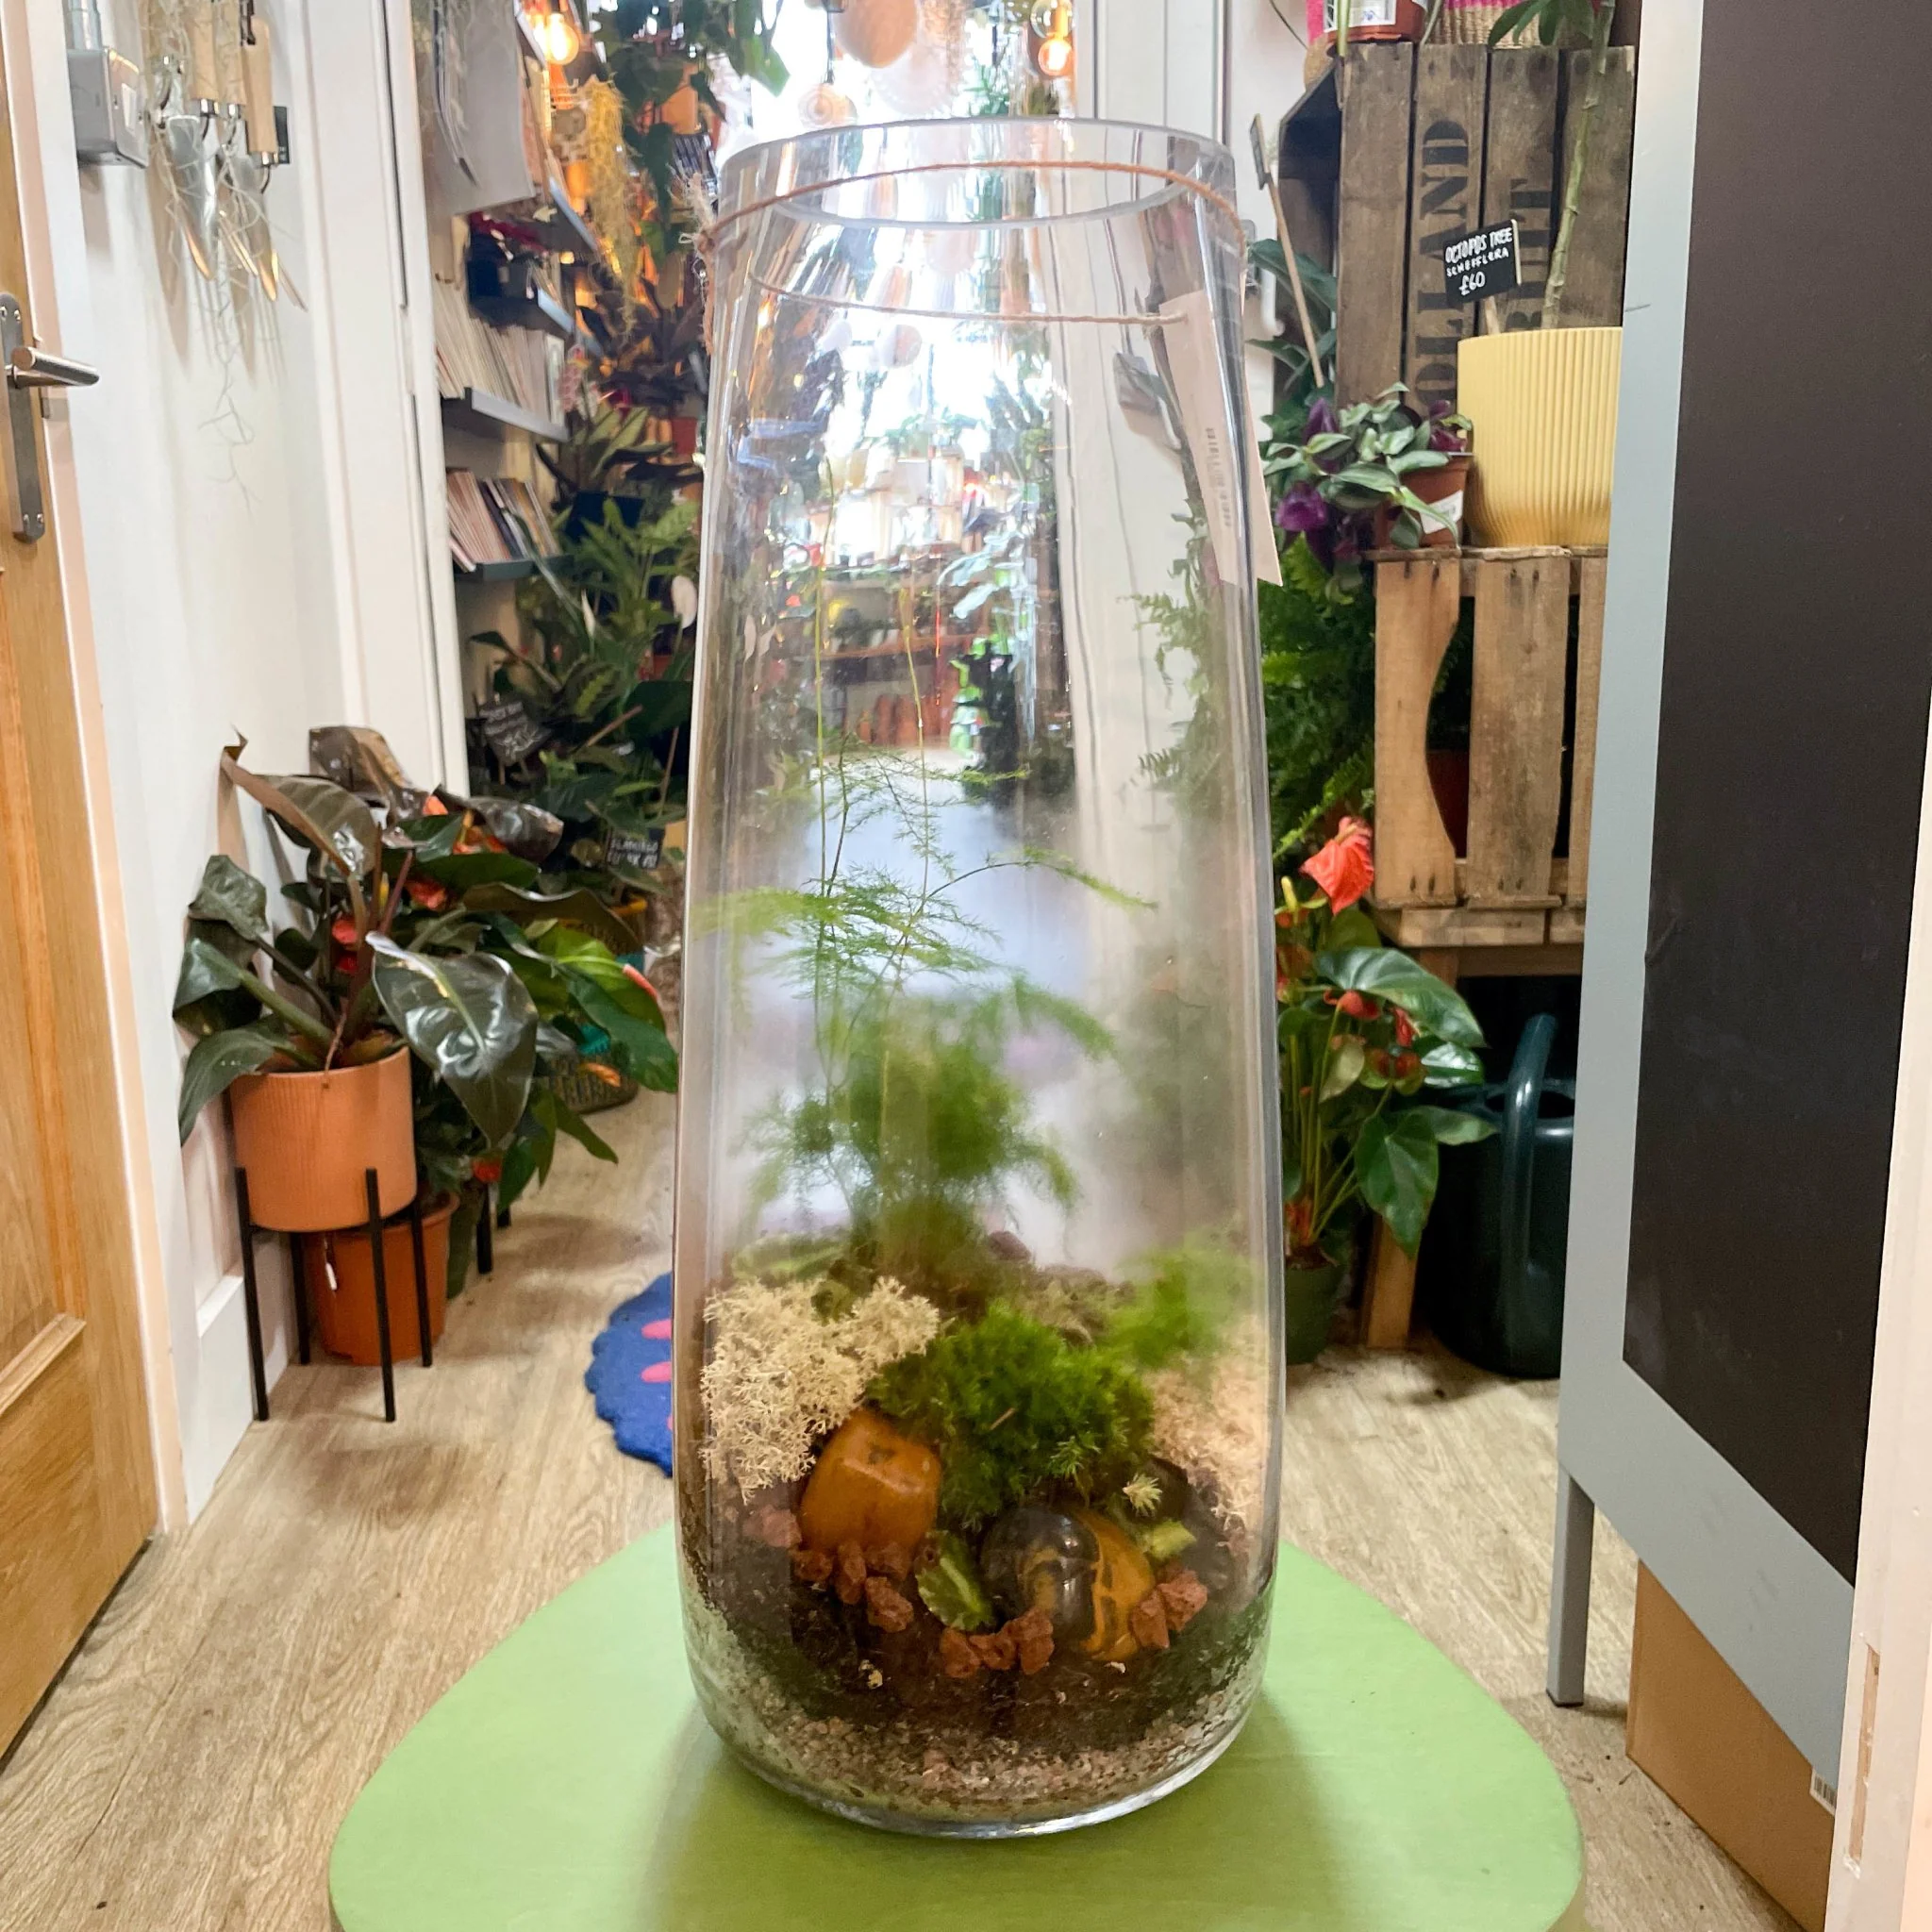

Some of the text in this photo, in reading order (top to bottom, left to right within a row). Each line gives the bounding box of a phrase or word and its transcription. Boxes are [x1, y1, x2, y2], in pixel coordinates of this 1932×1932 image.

[1445, 227, 1513, 264] OCTOPUS TREE
[1458, 271, 1486, 296] £60
